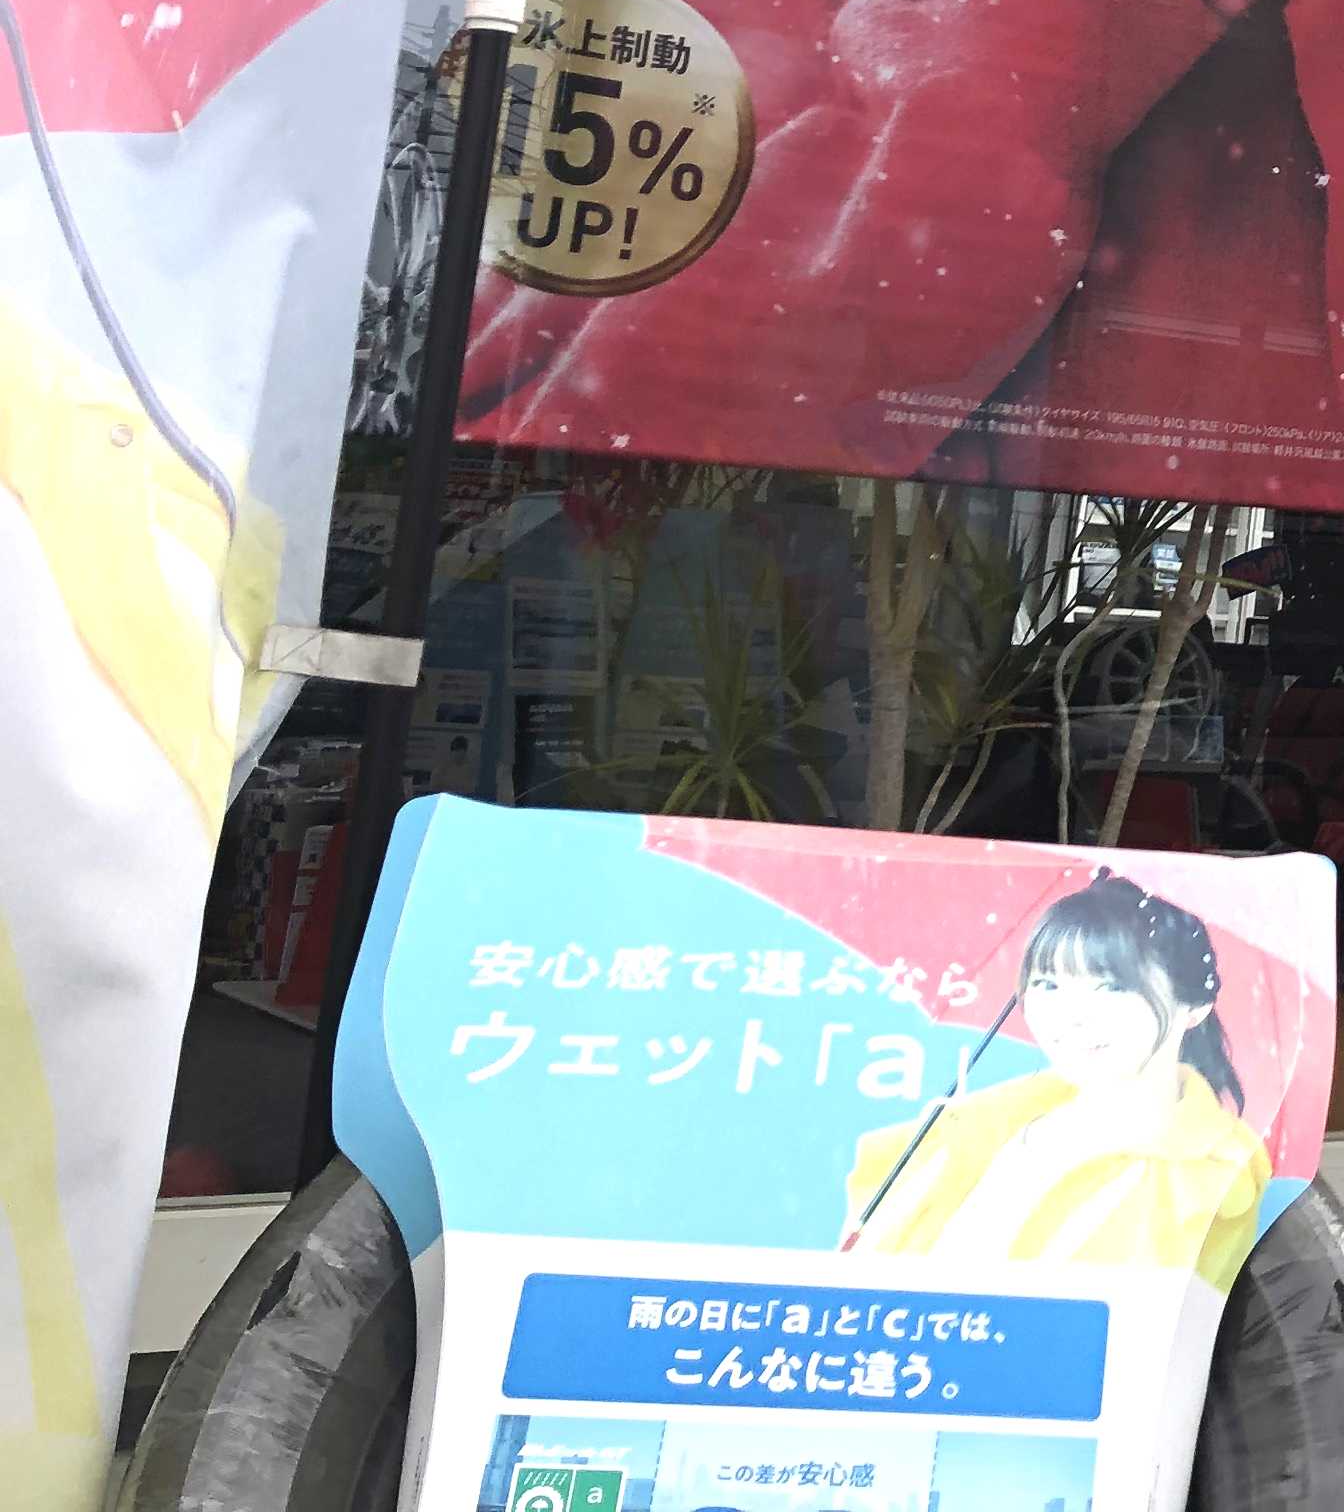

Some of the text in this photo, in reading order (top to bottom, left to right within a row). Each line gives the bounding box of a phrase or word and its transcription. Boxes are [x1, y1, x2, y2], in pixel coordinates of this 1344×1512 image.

[516, 191, 641, 261] UP!
[469, 939, 979, 1007] 安心感で選ぶなら
[448, 1010, 970, 1102] ウェット「a」
[627, 1294, 1008, 1345] 雨の日に「a」と「c」では、
[664, 1346, 961, 1400] こんなに違う。
[716, 1460, 877, 1489] この差が安心感
